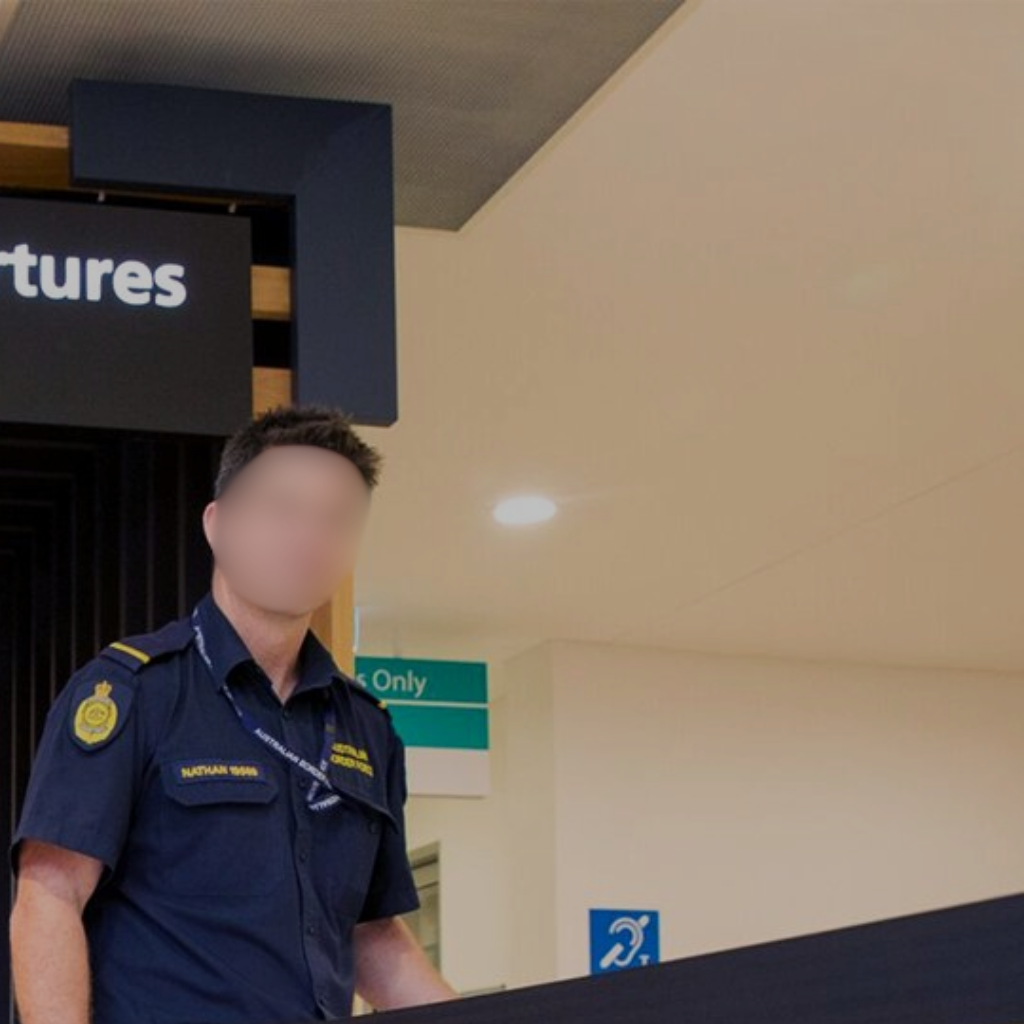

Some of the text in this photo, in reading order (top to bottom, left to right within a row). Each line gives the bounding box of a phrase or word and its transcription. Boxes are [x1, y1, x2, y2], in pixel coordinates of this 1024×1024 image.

[372, 669, 427, 699] Only
[254, 727, 301, 764] AUSTRALIAN
[181, 764, 228, 779] NATHAN
[329, 753, 356, 769] ORDER
